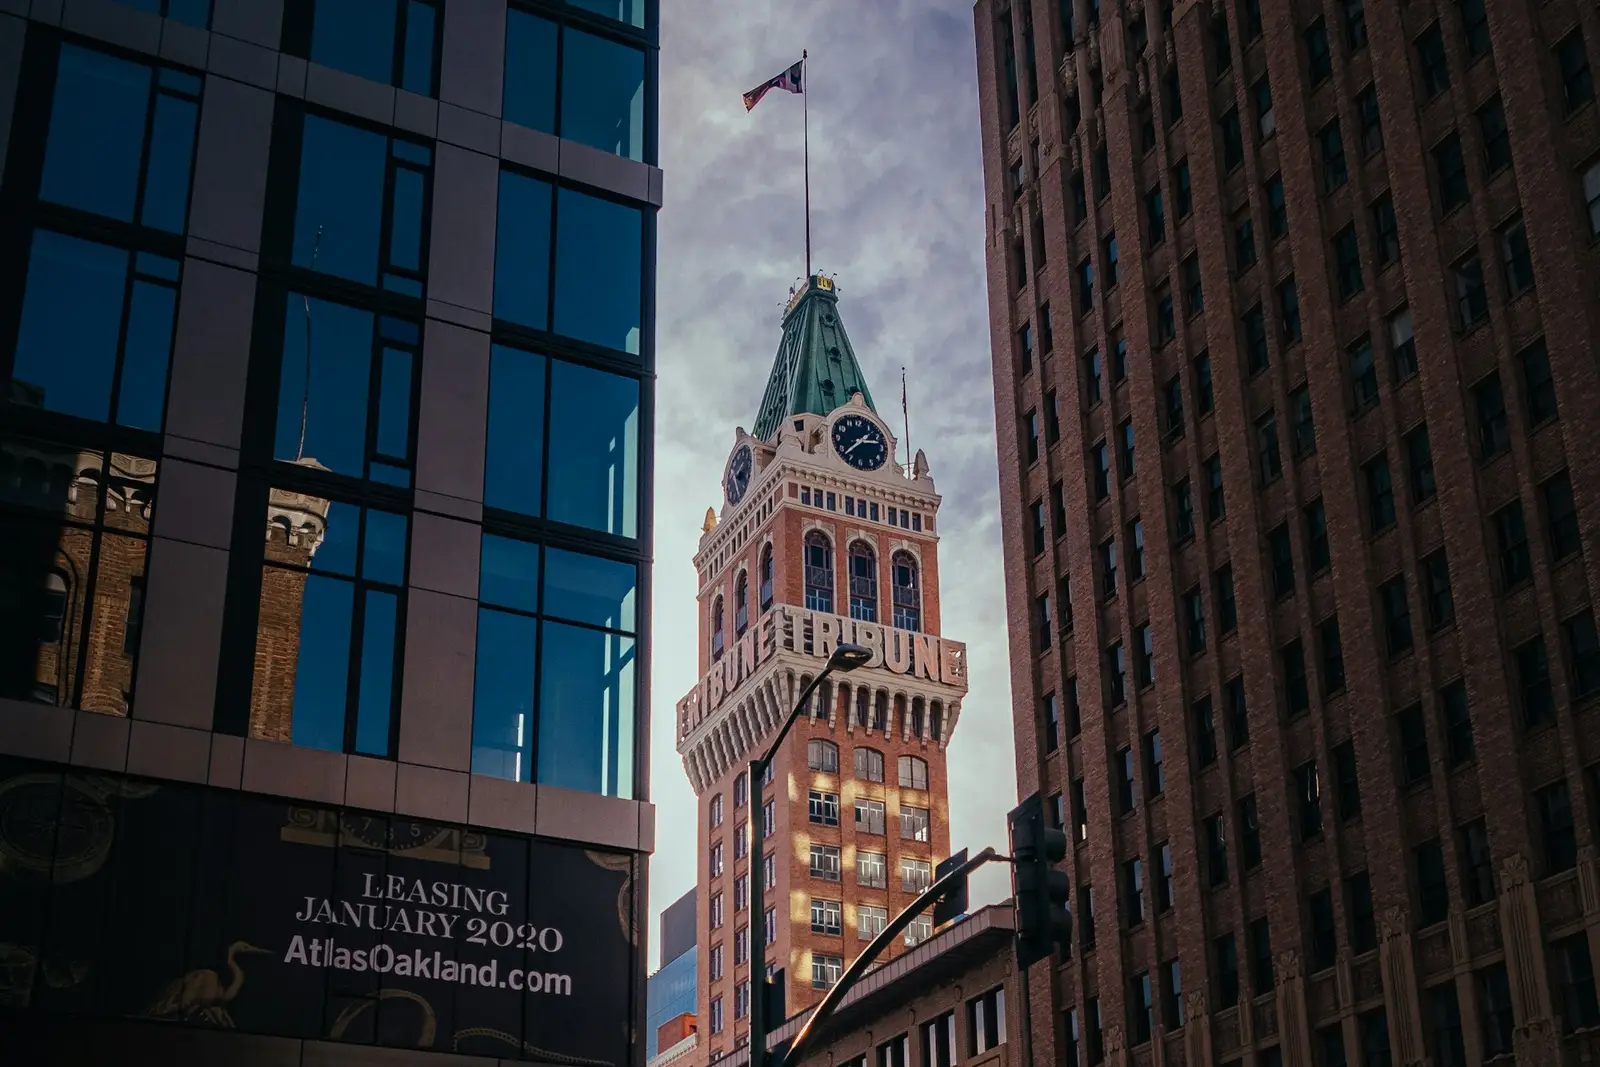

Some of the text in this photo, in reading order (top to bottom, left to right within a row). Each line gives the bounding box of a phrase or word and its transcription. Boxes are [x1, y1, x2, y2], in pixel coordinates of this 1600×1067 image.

[784, 604, 964, 687] TRIBUNE
[361, 816, 372, 831] 7
[410, 823, 420, 837] 5
[362, 872, 510, 916] LEASING
[295, 896, 563, 953] JANUARY 2020
[283, 935, 572, 996] AtlasOakland.com
